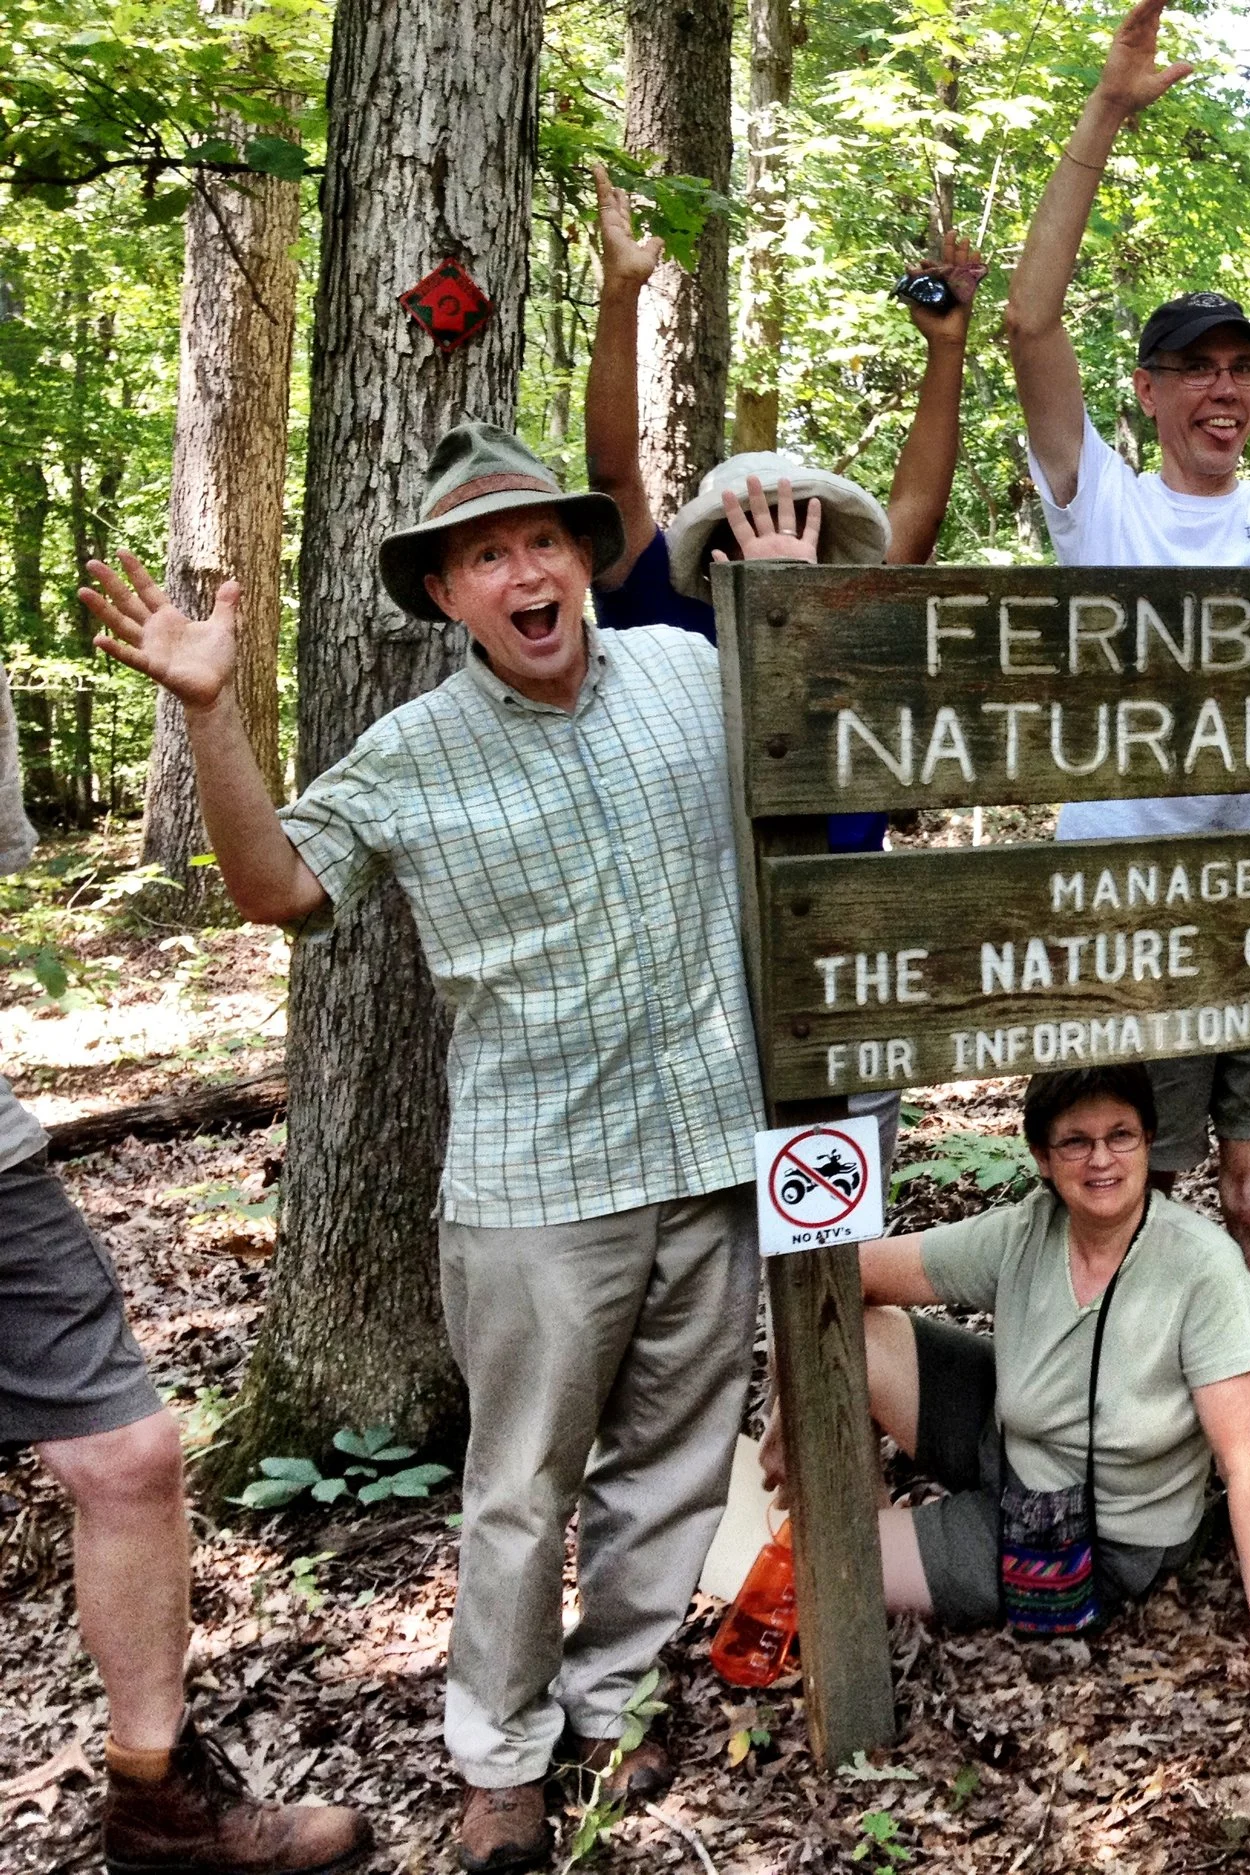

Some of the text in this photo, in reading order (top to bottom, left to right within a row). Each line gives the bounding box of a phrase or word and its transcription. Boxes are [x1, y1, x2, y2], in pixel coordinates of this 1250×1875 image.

[814, 947, 932, 1008] THE
[980, 925, 1201, 996] NATURE
[827, 1037, 917, 1086] FOR
[792, 1231, 811, 1245] NO
